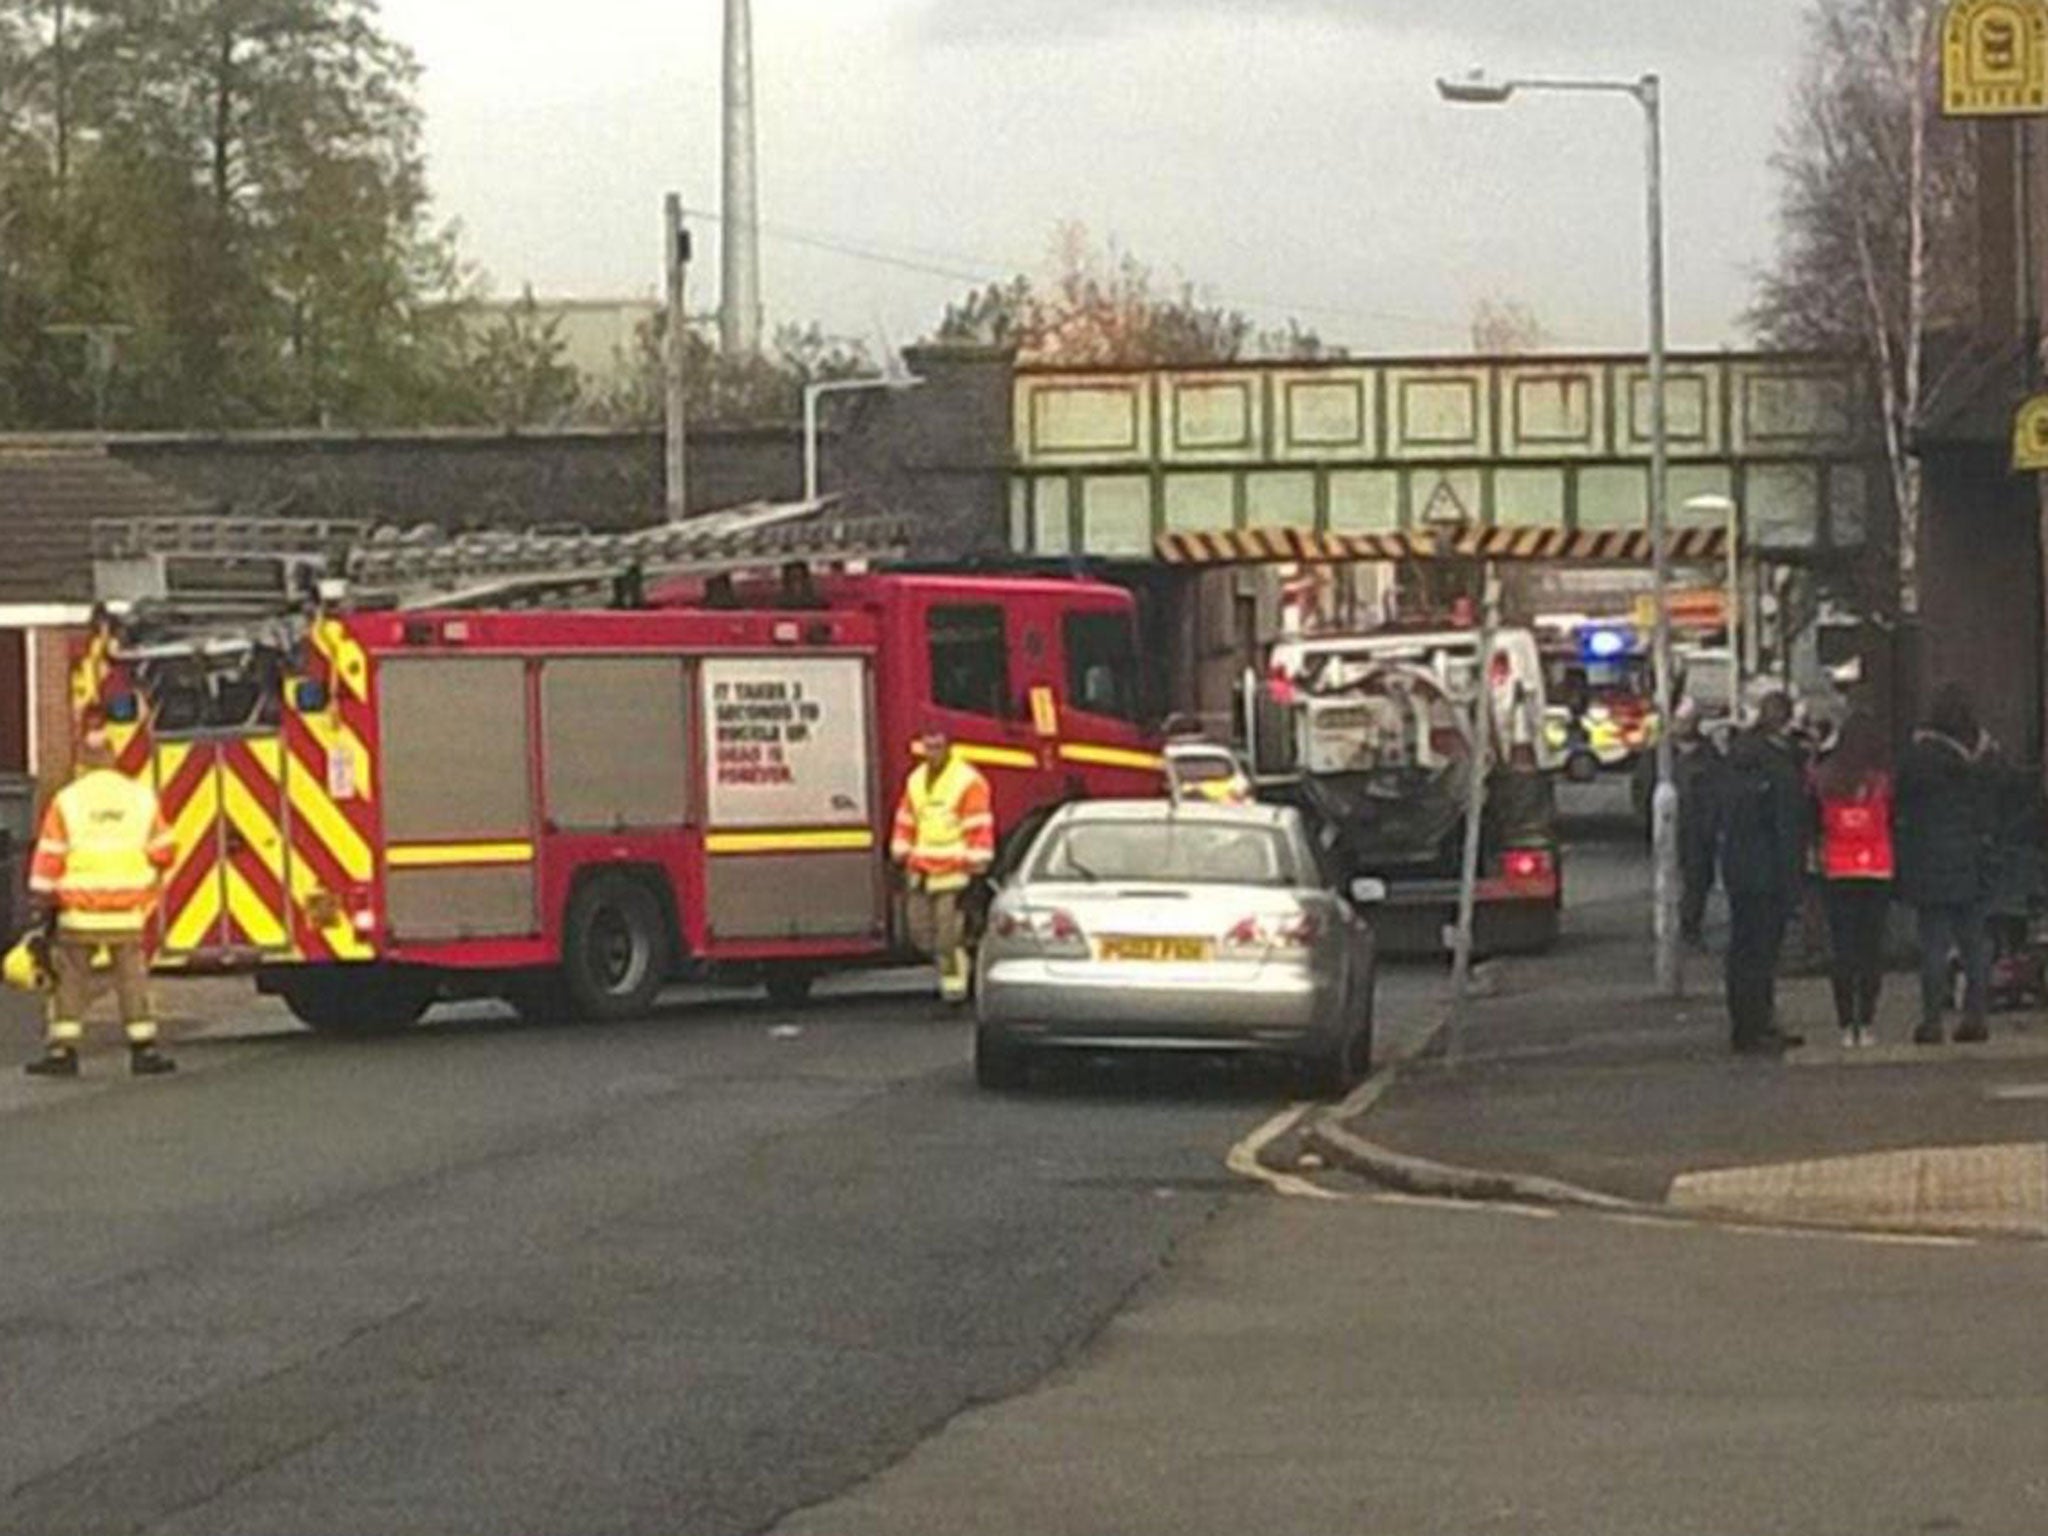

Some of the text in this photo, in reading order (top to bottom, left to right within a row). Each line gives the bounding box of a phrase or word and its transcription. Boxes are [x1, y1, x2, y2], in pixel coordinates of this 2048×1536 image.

[714, 682, 729, 700] IT
[734, 682, 786, 700] TAKES
[717, 703, 820, 721] SECONDS TO
